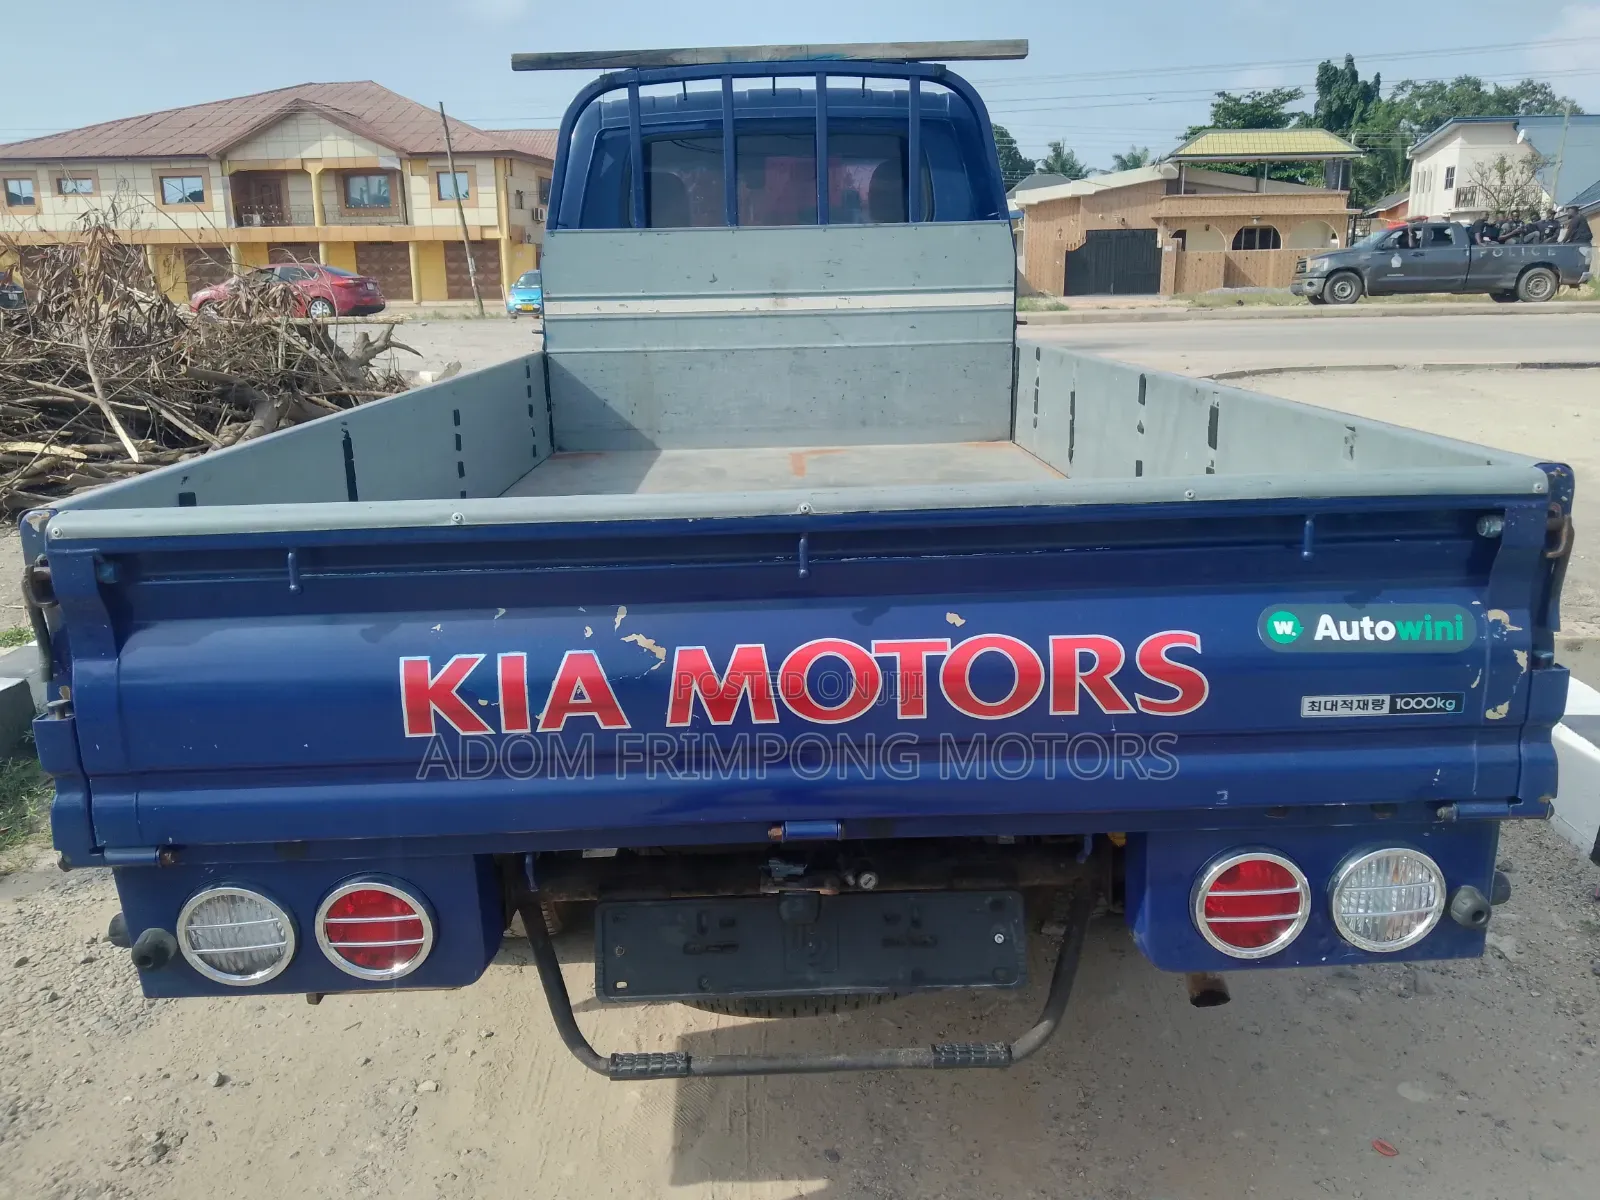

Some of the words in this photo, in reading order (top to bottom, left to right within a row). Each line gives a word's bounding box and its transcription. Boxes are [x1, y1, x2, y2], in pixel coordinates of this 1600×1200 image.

[1314, 613, 1463, 641] Autowini
[398, 649, 632, 738] KIA
[665, 630, 1209, 727] MOTORS
[1306, 698, 1386, 713] 최대적재량
[1395, 696, 1456, 710] 1000kg
